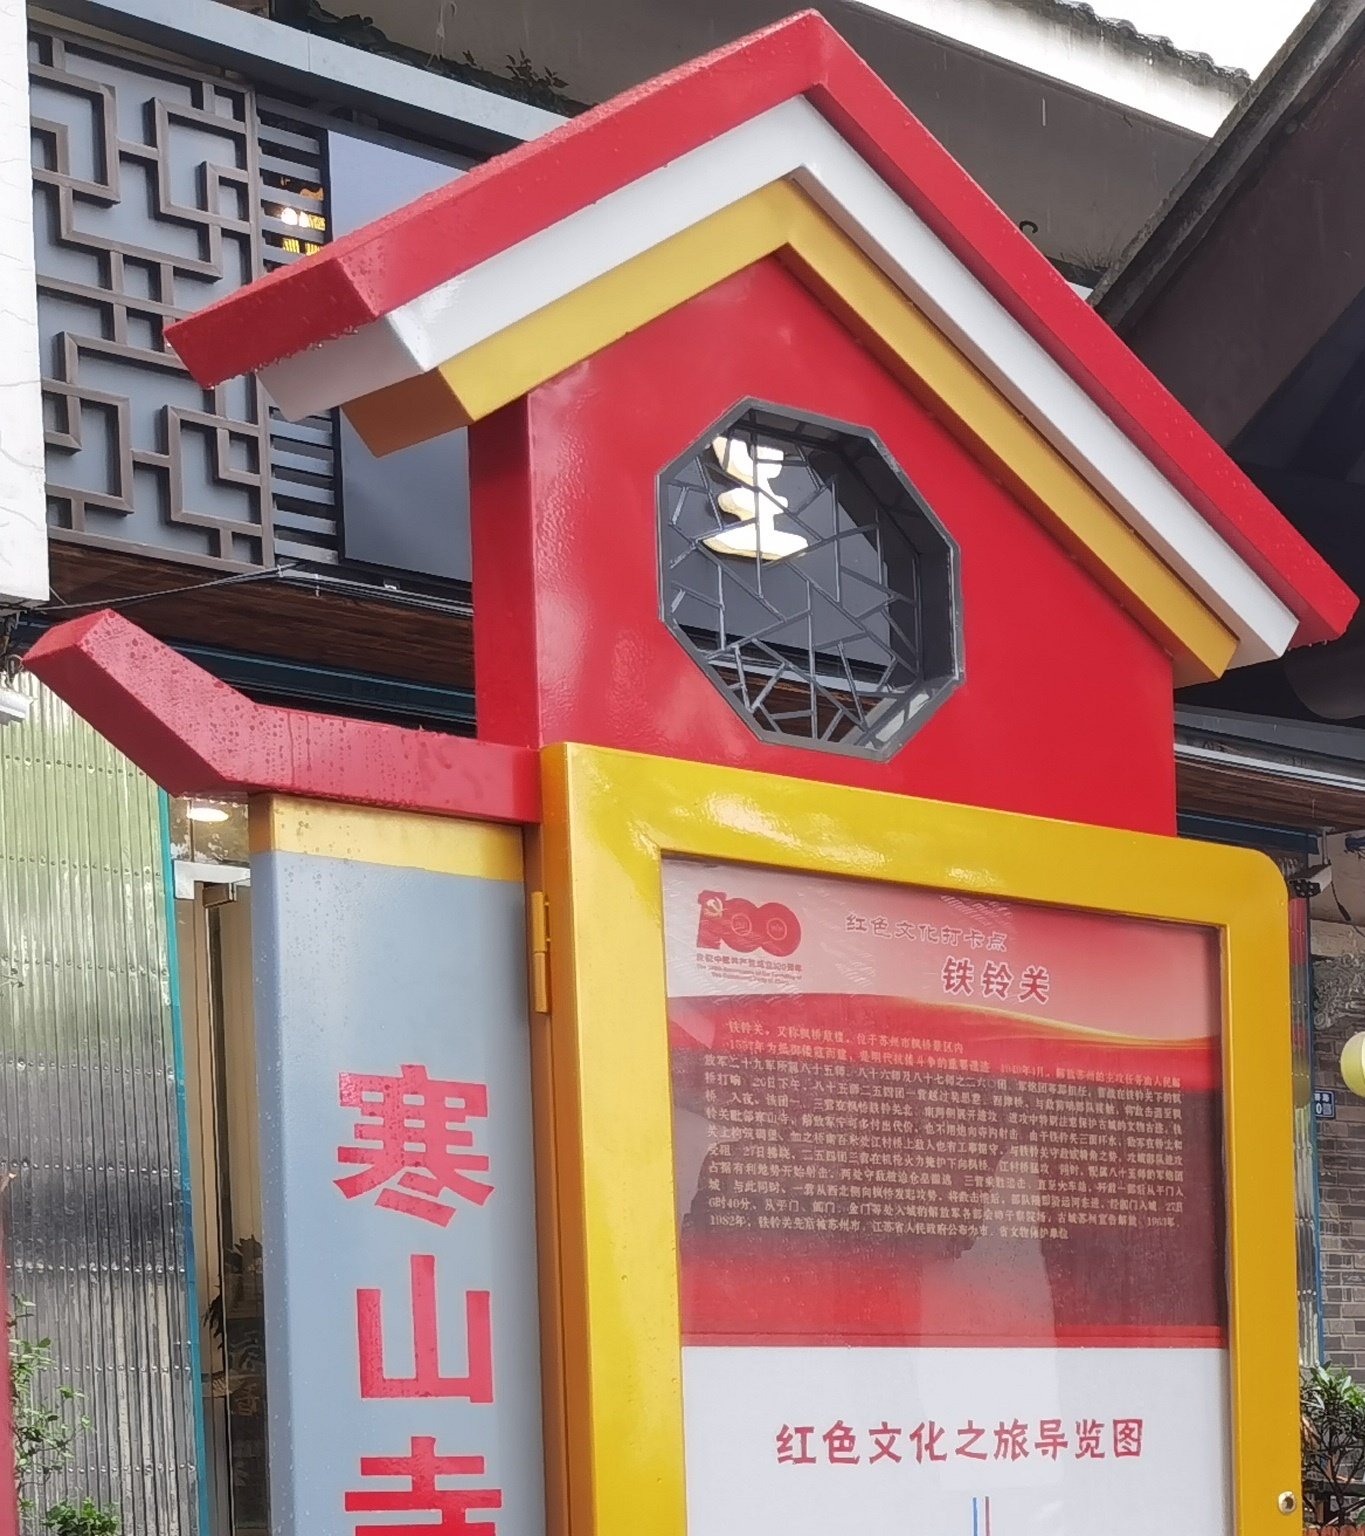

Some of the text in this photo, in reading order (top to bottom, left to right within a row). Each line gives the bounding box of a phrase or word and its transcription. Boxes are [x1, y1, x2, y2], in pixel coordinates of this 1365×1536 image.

[941, 957, 1049, 1003] 铁铃关
[775, 1418, 1144, 1465] 红色文化之旅导览图
